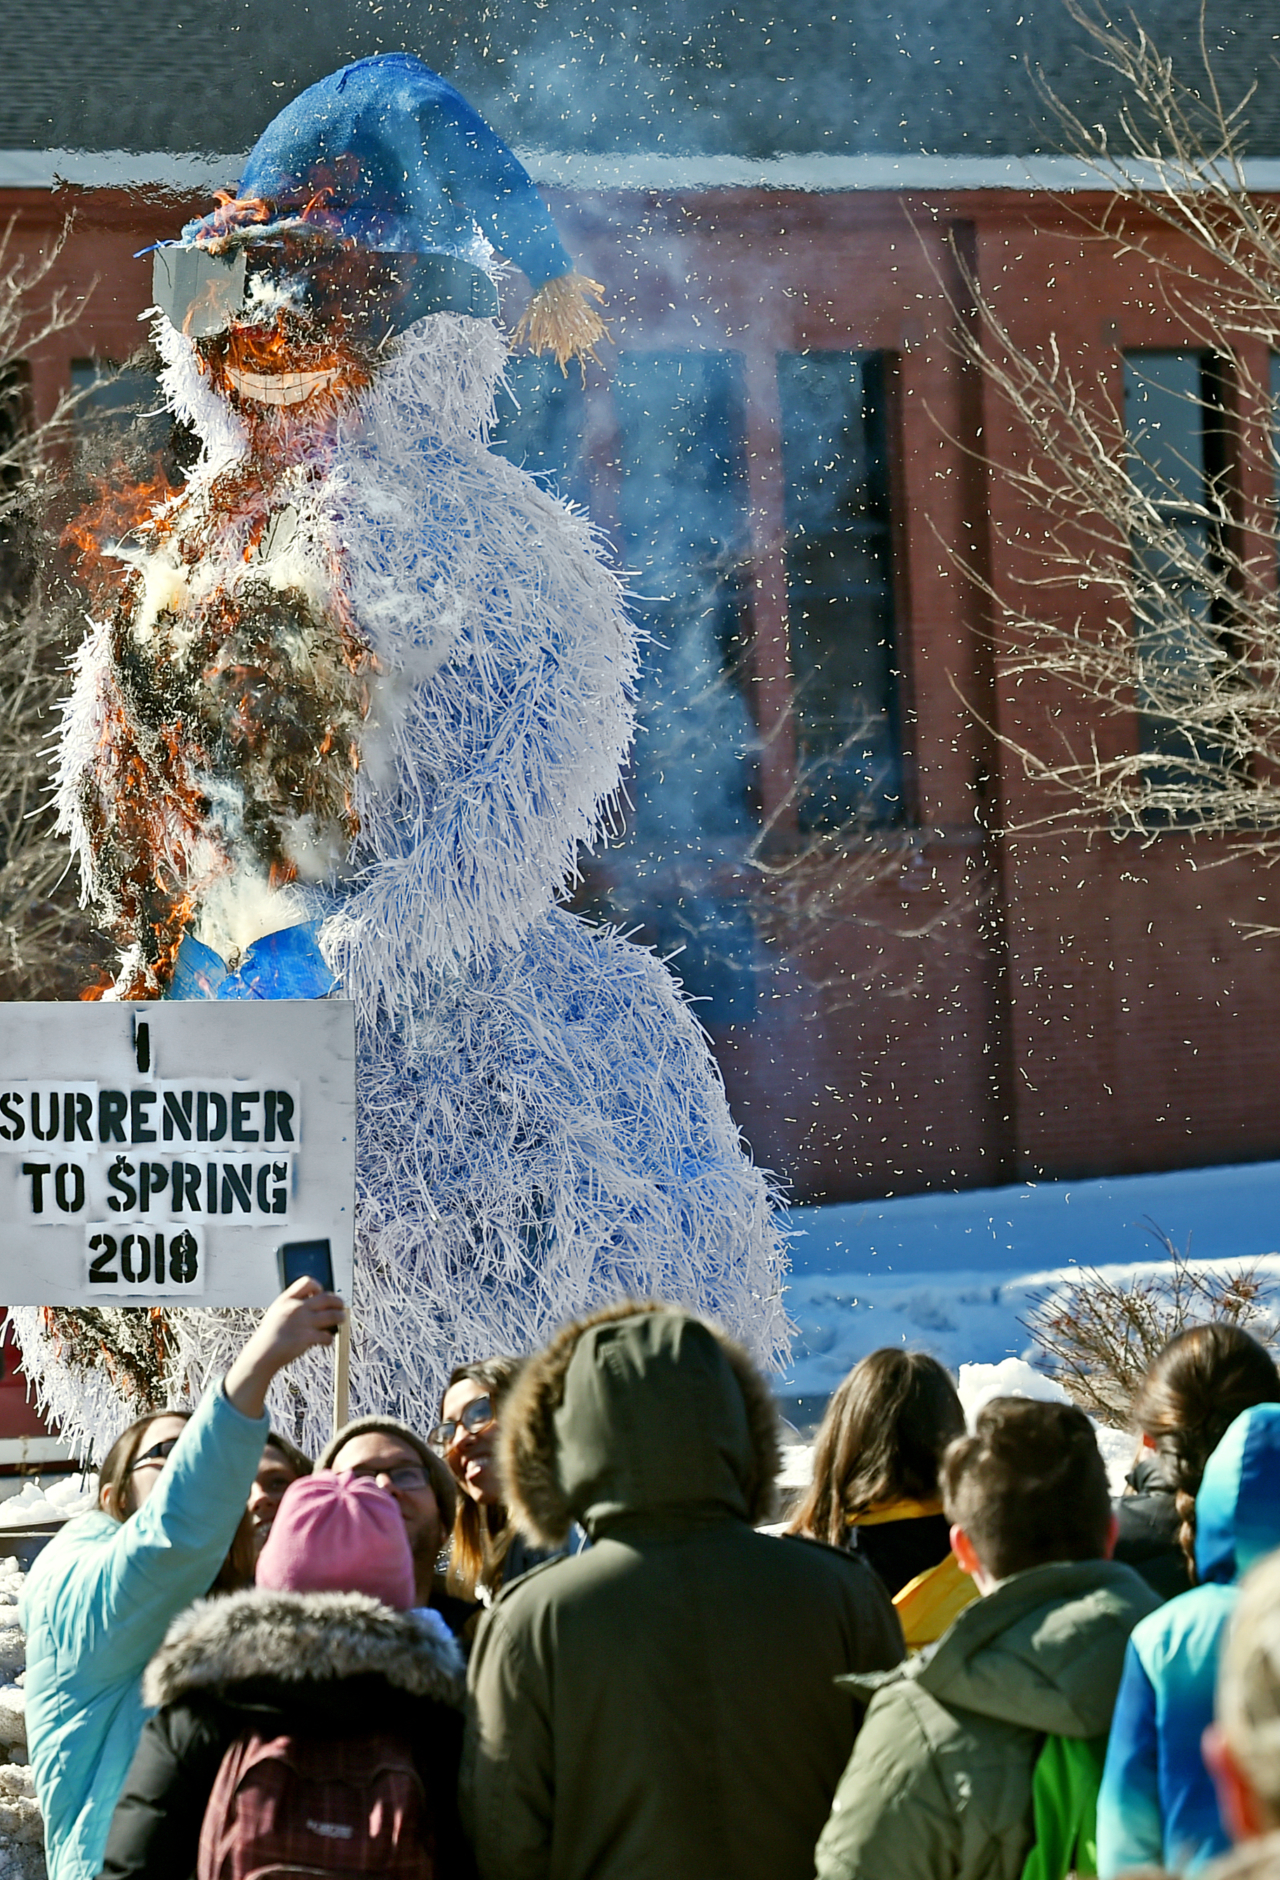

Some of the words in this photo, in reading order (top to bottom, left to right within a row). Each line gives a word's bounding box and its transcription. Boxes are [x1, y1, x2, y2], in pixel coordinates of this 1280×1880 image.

[136, 1022, 150, 1073] I
[0, 1090, 295, 1143] SURRENDER
[23, 1163, 85, 1213] TO
[107, 1156, 287, 1214] SPRING
[89, 1231, 198, 1284] 2018
